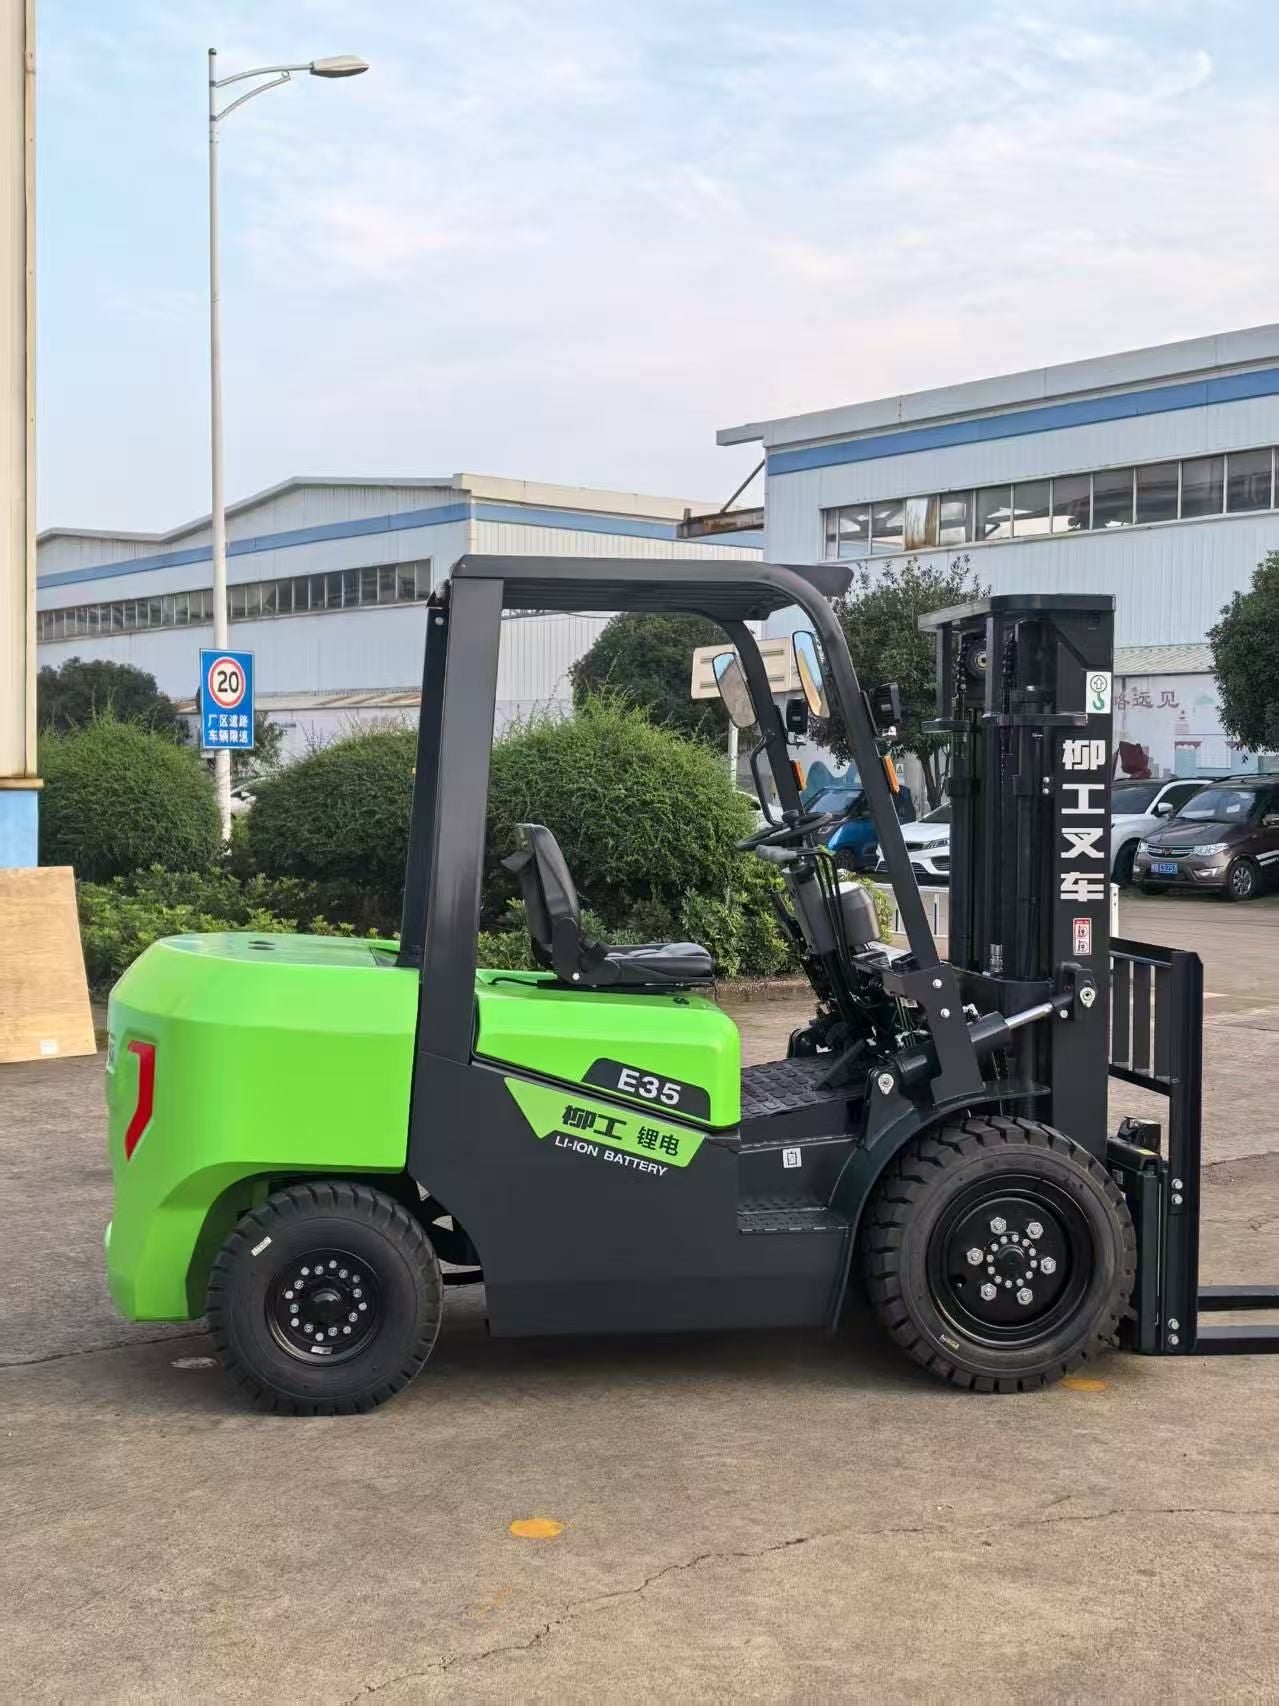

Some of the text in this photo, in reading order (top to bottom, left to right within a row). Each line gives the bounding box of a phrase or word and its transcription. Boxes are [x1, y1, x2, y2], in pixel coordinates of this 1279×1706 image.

[217, 670, 239, 693] 20
[208, 714, 249, 728] 厂区道路
[208, 730, 249, 744] 车辆限速
[1060, 739, 1106, 903] 柳工叉车
[617, 1067, 682, 1105] E35
[562, 1105, 680, 1157] 柳工 锂电
[555, 1136, 669, 1176] LI-ION BATTERY
